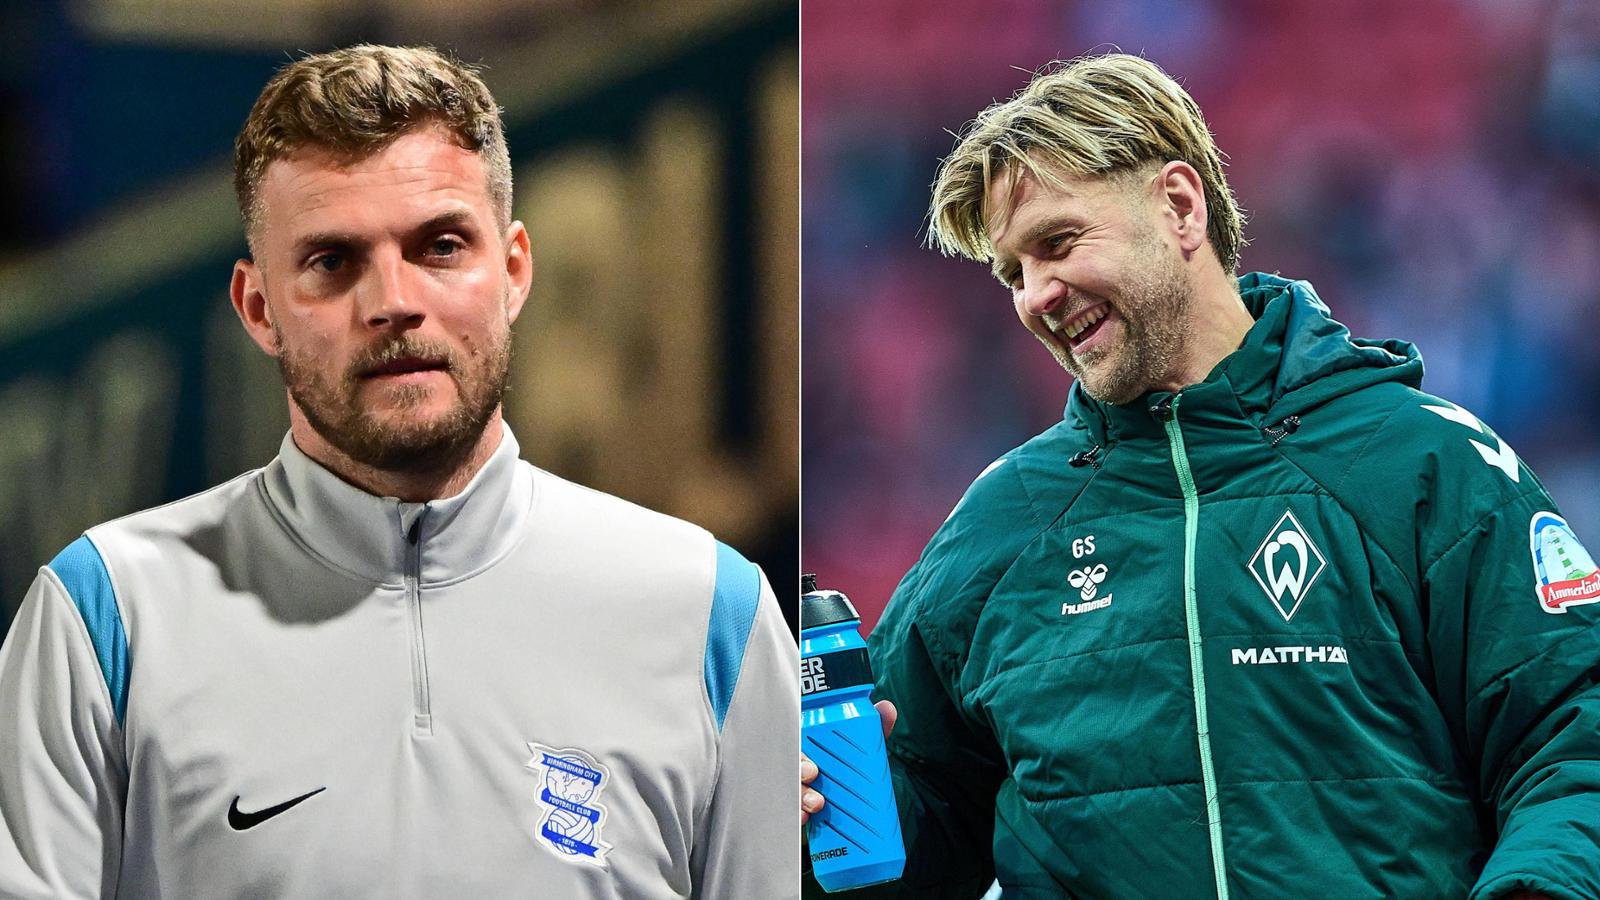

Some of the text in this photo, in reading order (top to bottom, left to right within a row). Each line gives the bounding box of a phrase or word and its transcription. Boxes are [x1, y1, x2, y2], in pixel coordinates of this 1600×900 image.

[1072, 535, 1096, 559] GS
[1061, 593, 1113, 616] hummel
[547, 757, 599, 781] BIRMINGHAM CITY
[548, 796, 592, 817] FOOTBALL CLUB
